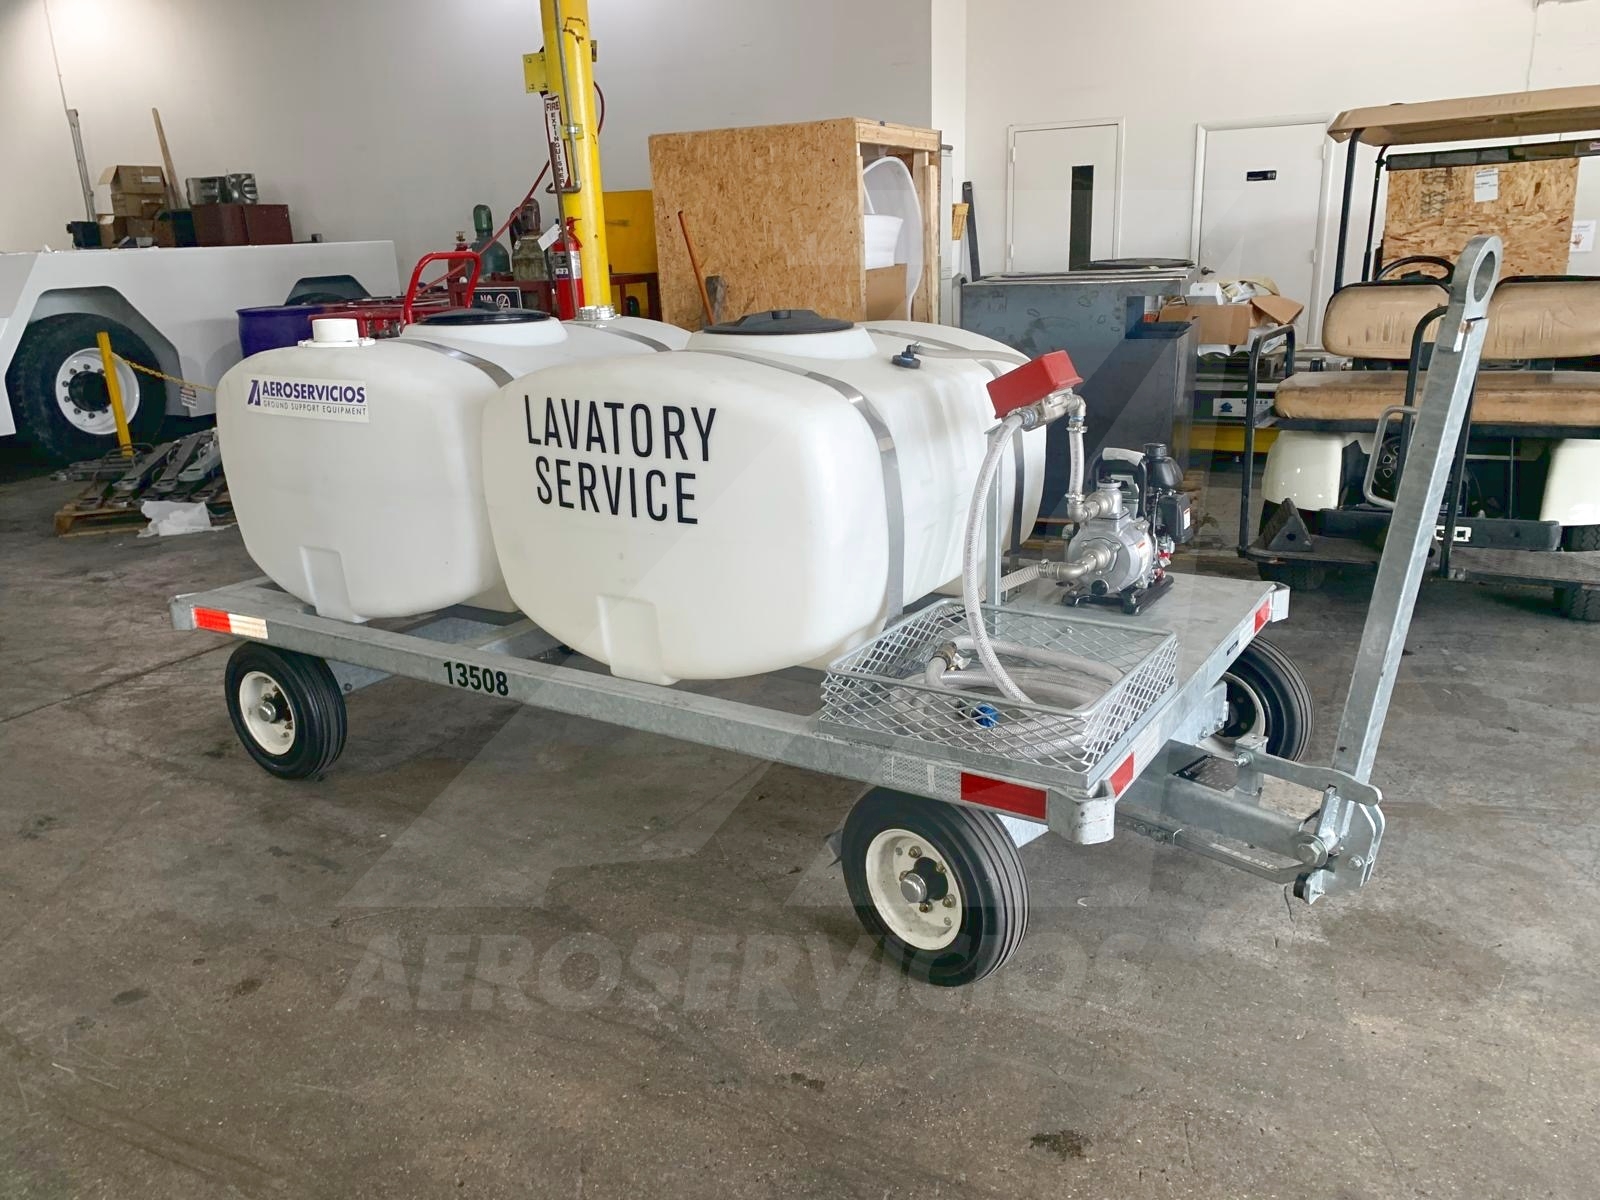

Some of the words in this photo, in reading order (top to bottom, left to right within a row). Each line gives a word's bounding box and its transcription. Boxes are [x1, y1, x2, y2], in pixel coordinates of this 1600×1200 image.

[546, 101, 560, 111] FIRE
[551, 112, 565, 185] EXTINGUISHER
[262, 381, 366, 403] AEROSERVICIOS
[263, 400, 289, 410] GROUND
[291, 402, 319, 412] SUPPORT
[323, 405, 366, 416] EQUIPMENT
[524, 395, 717, 462] LAVATORY
[535, 456, 698, 525] SERVICE
[443, 661, 509, 696] 13508
